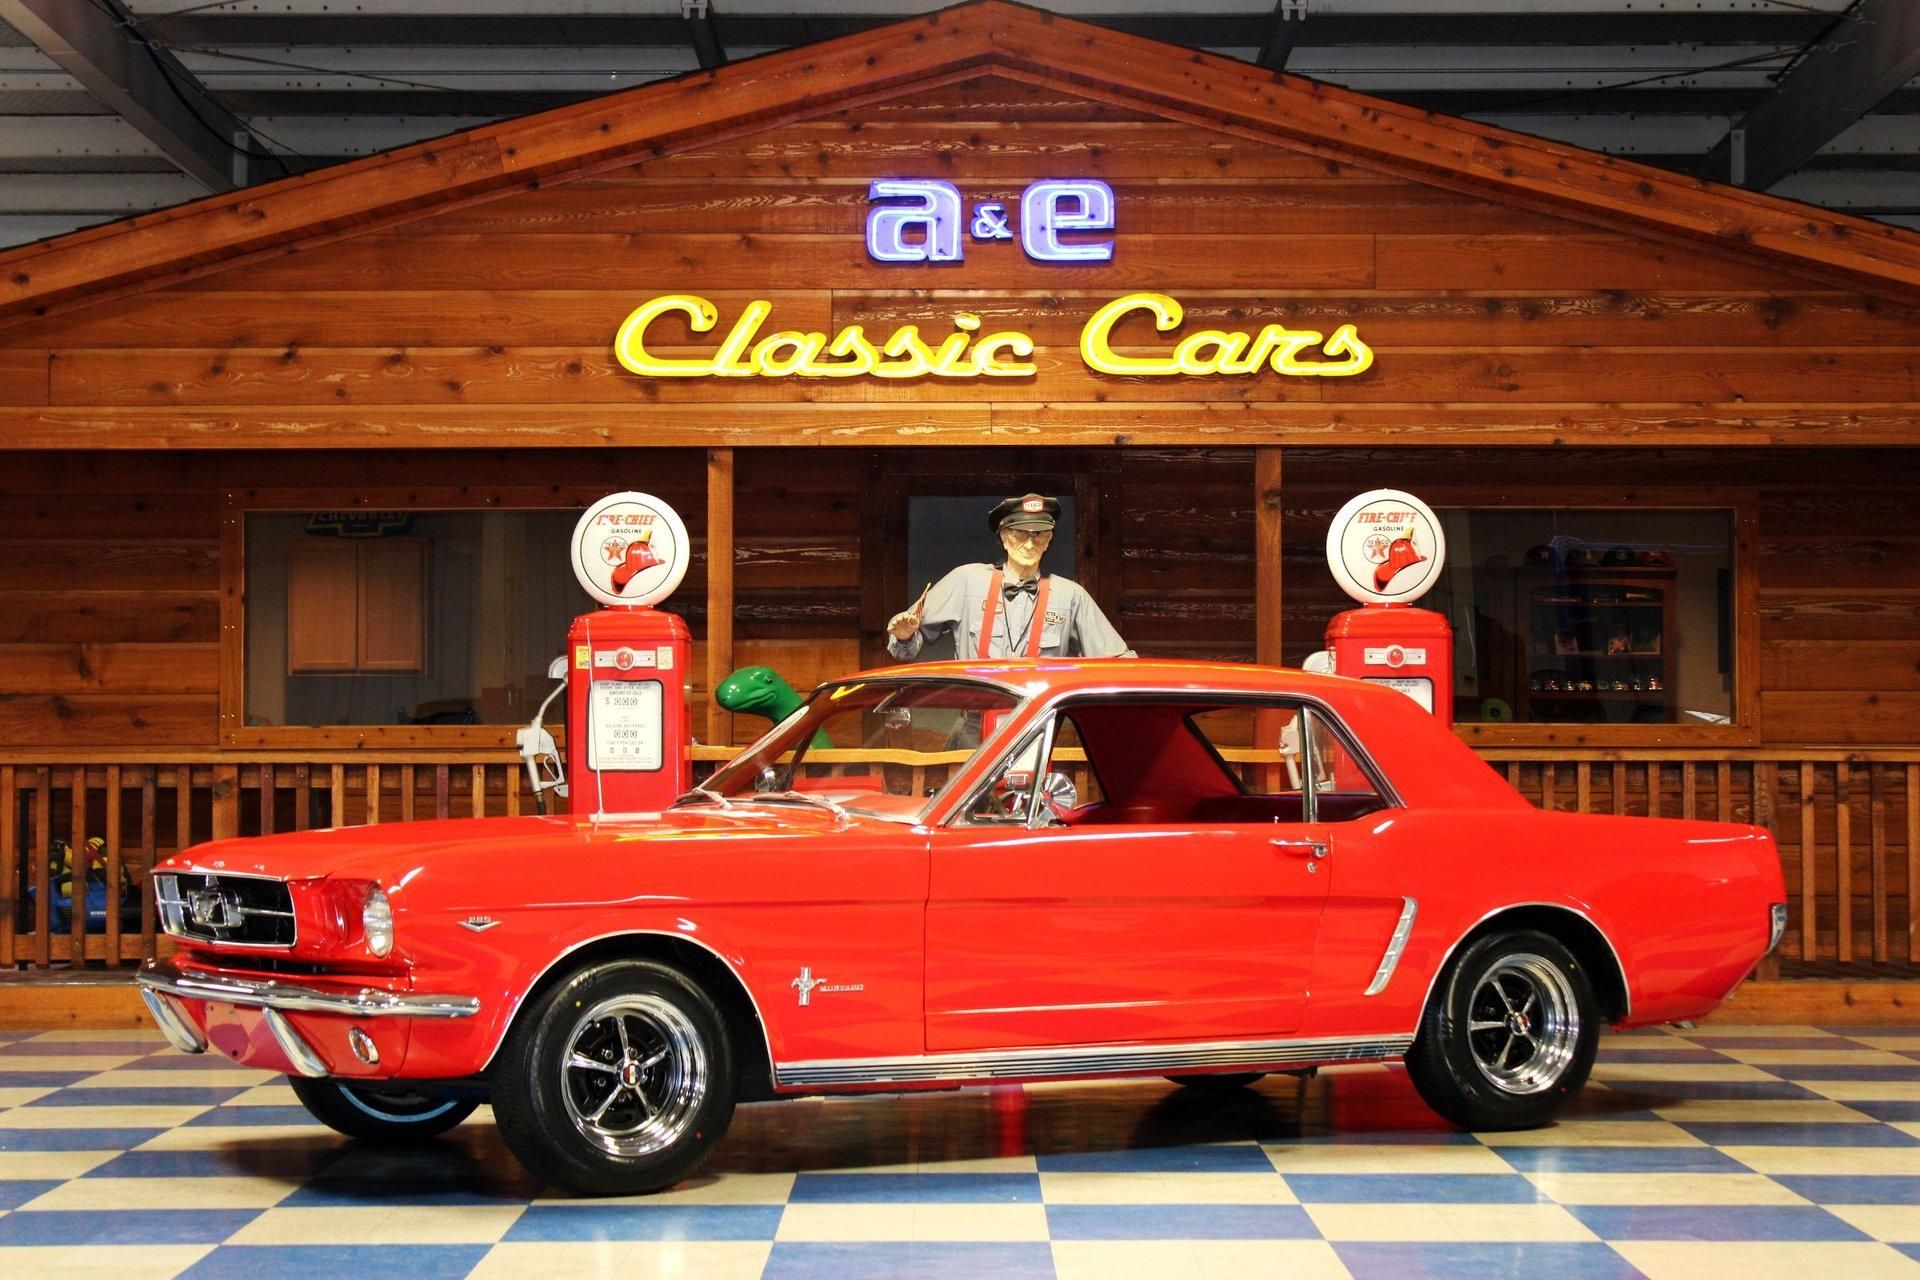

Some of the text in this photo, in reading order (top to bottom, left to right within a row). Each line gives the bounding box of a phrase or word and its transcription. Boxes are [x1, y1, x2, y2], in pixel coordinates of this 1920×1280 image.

[866, 179, 1116, 263] a & e
[614, 292, 1375, 378] Classic Cars
